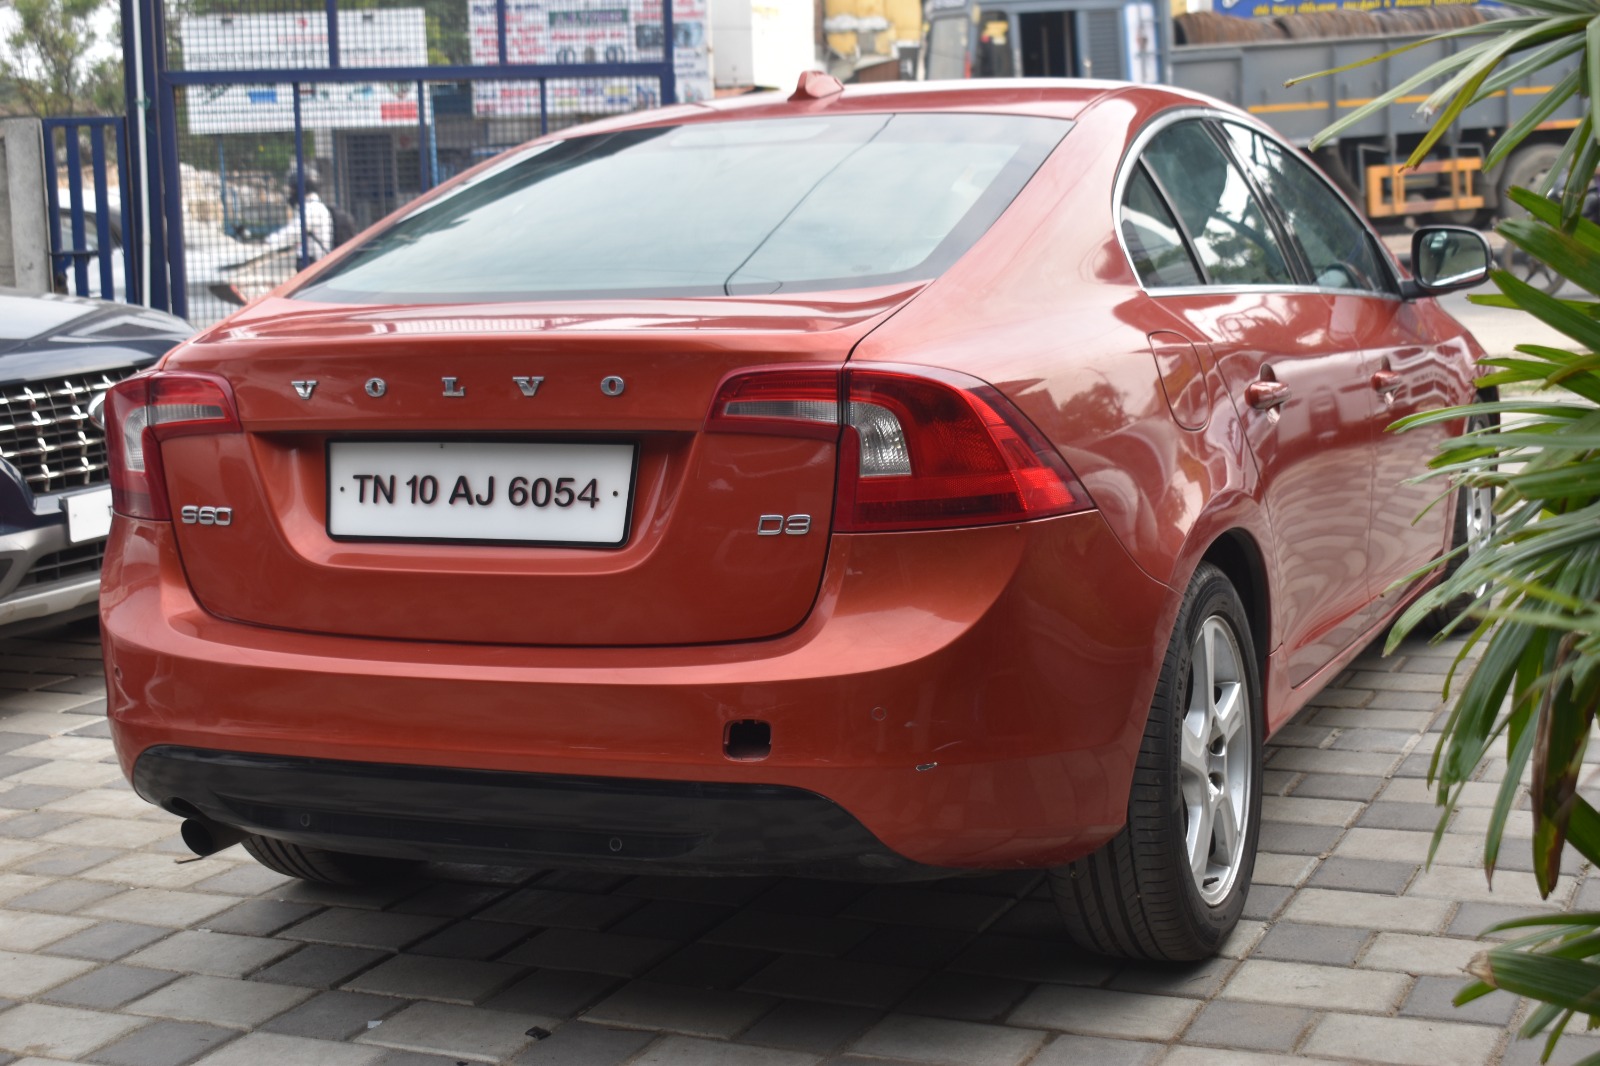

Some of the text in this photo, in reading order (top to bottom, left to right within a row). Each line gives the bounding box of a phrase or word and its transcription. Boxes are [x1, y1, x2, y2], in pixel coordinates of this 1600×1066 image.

[291, 375, 625, 400] VOLVO
[353, 474, 600, 508] TN 10 AJ 6054
[181, 505, 232, 526] S60
[757, 514, 811, 536] D3
